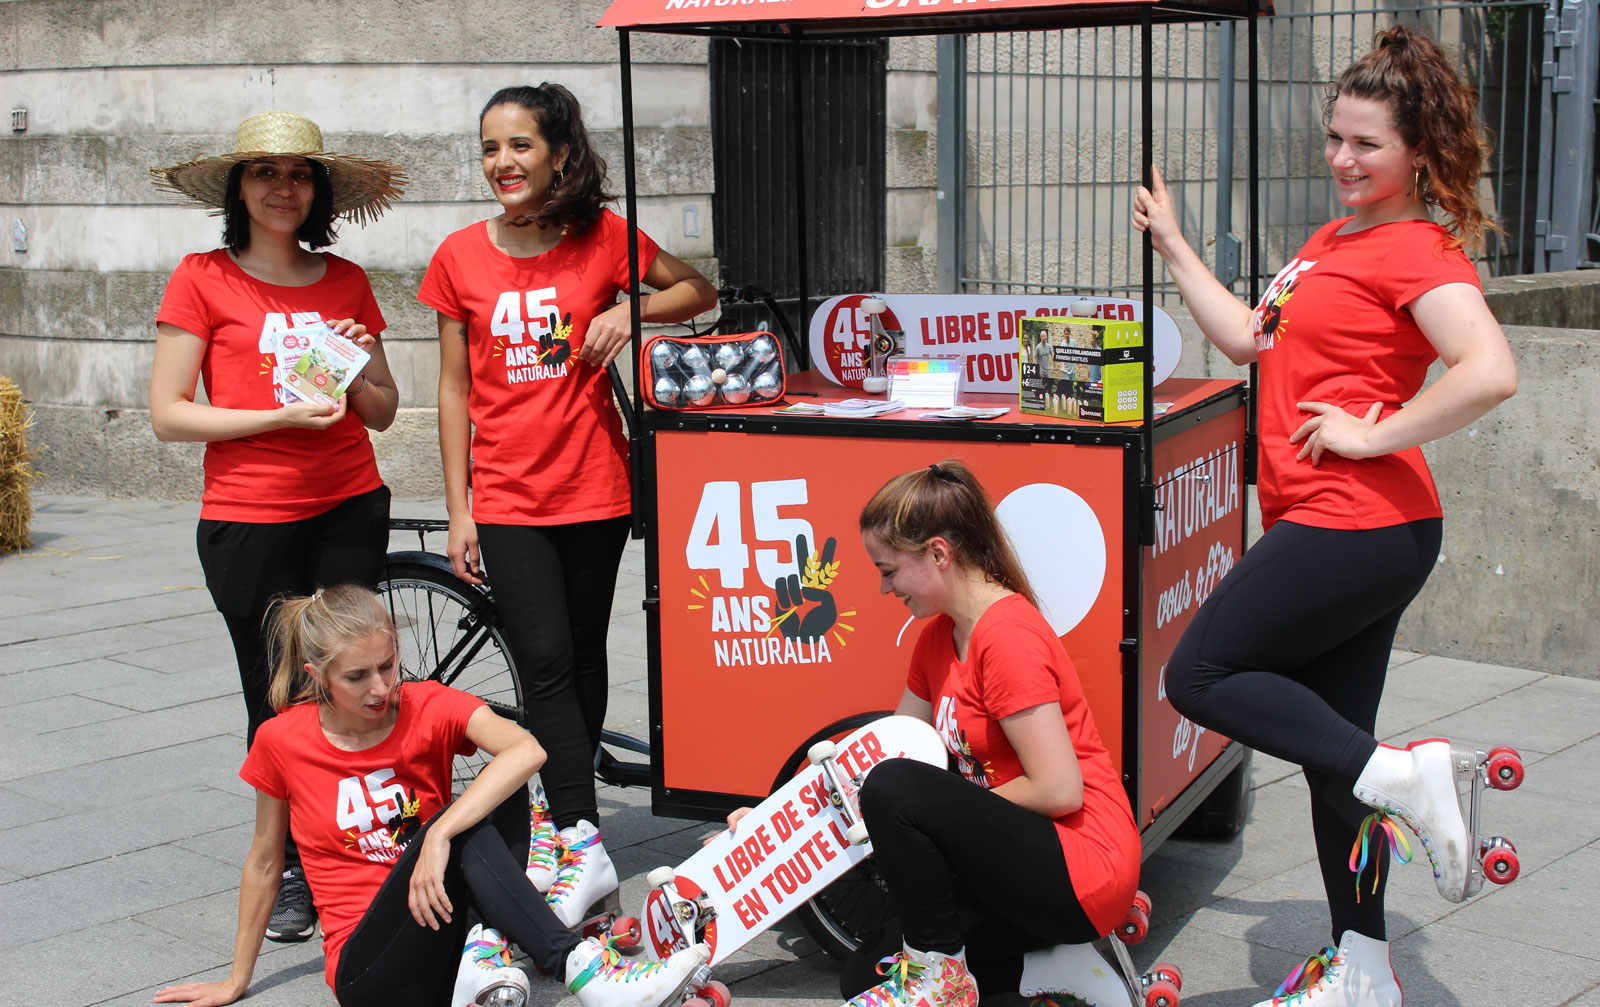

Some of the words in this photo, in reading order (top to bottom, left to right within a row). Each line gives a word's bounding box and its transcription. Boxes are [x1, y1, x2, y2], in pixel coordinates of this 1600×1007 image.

[490, 286, 562, 345] 45
[920, 312, 992, 345] LIBRE
[505, 345, 537, 367] ANS
[507, 362, 568, 384] NATURALIA
[841, 352, 863, 368] ANS
[1152, 440, 1238, 559] NATURALIA
[685, 478, 816, 589] 45
[711, 595, 772, 633] ANS
[1156, 569, 1193, 630] vous
[713, 634, 833, 667] NATURALIA
[336, 767, 408, 834] 45
[712, 824, 777, 893] LIBRE
[770, 800, 805, 844] DE
[799, 730, 888, 819] SKTER
[357, 827, 394, 854] ANS
[732, 887, 770, 931] EN
[760, 830, 837, 905] TOUTE
